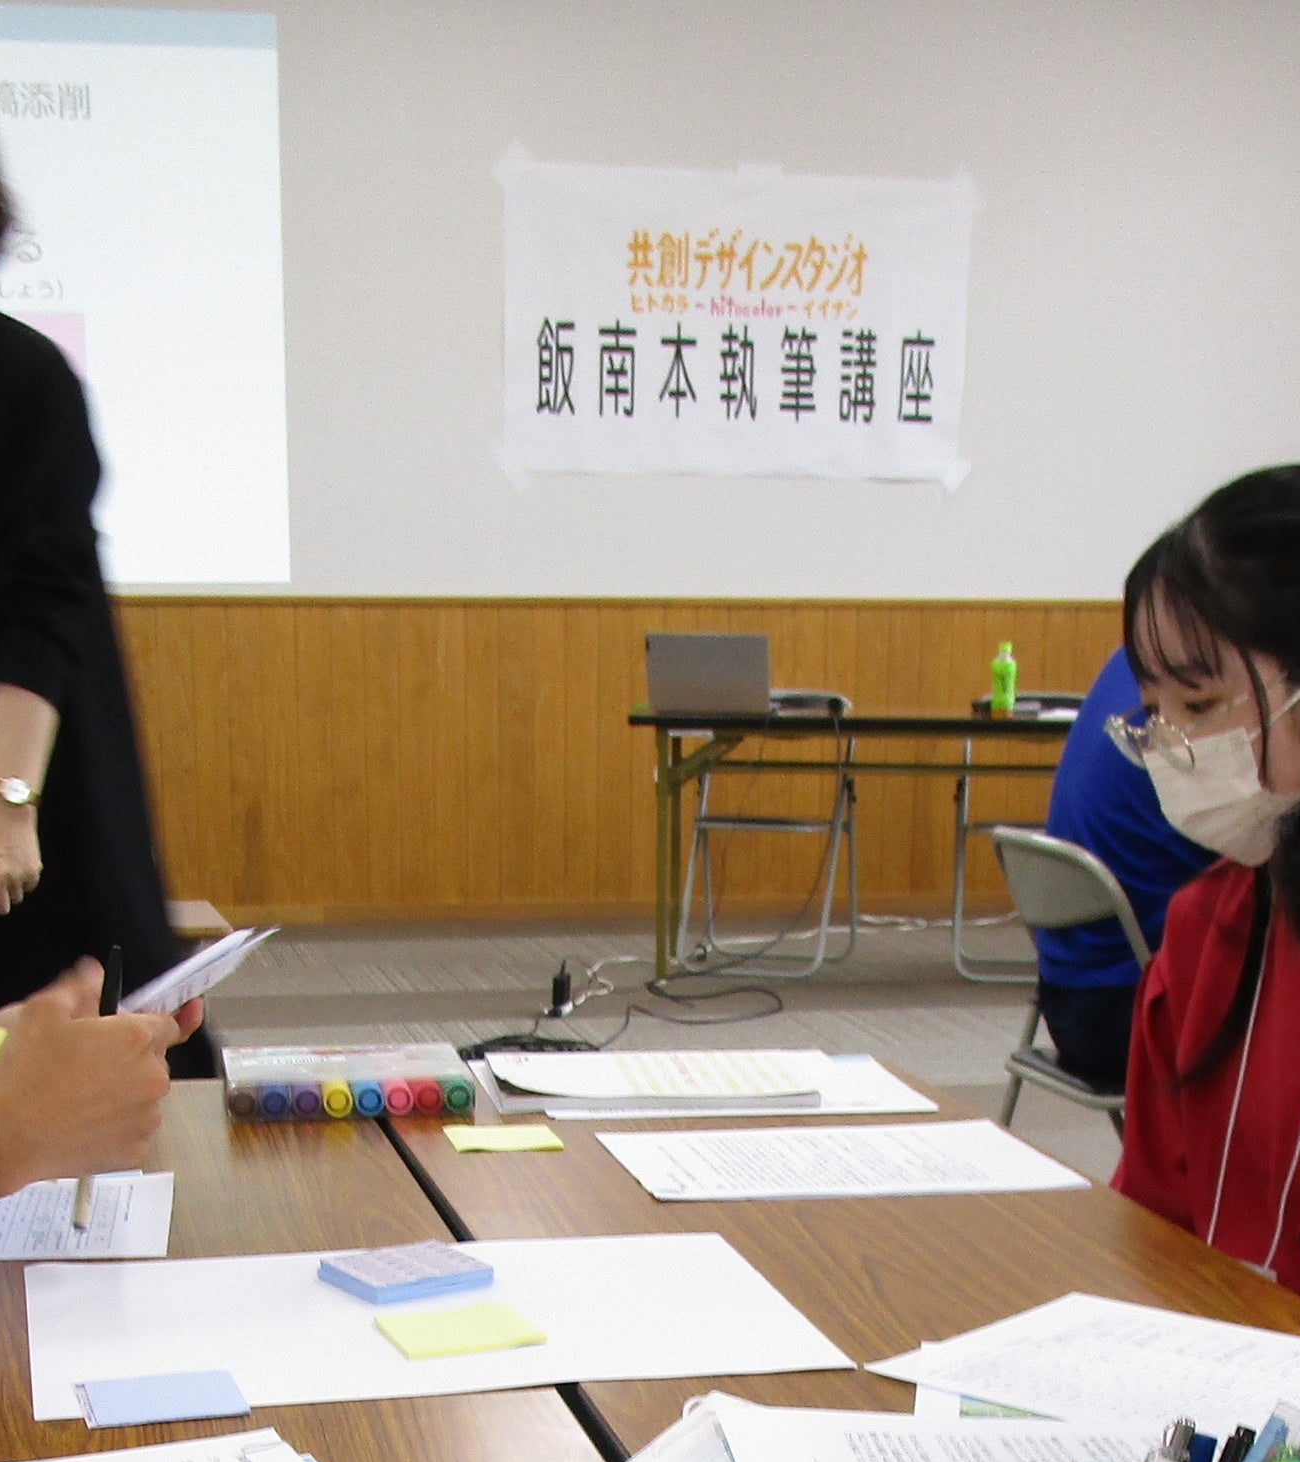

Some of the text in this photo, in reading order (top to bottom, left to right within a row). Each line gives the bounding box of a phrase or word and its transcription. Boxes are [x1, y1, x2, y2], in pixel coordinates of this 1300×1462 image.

[626, 228, 869, 297] 共創デザインスタジオ
[536, 316, 936, 424] 飯南本執筆講座
